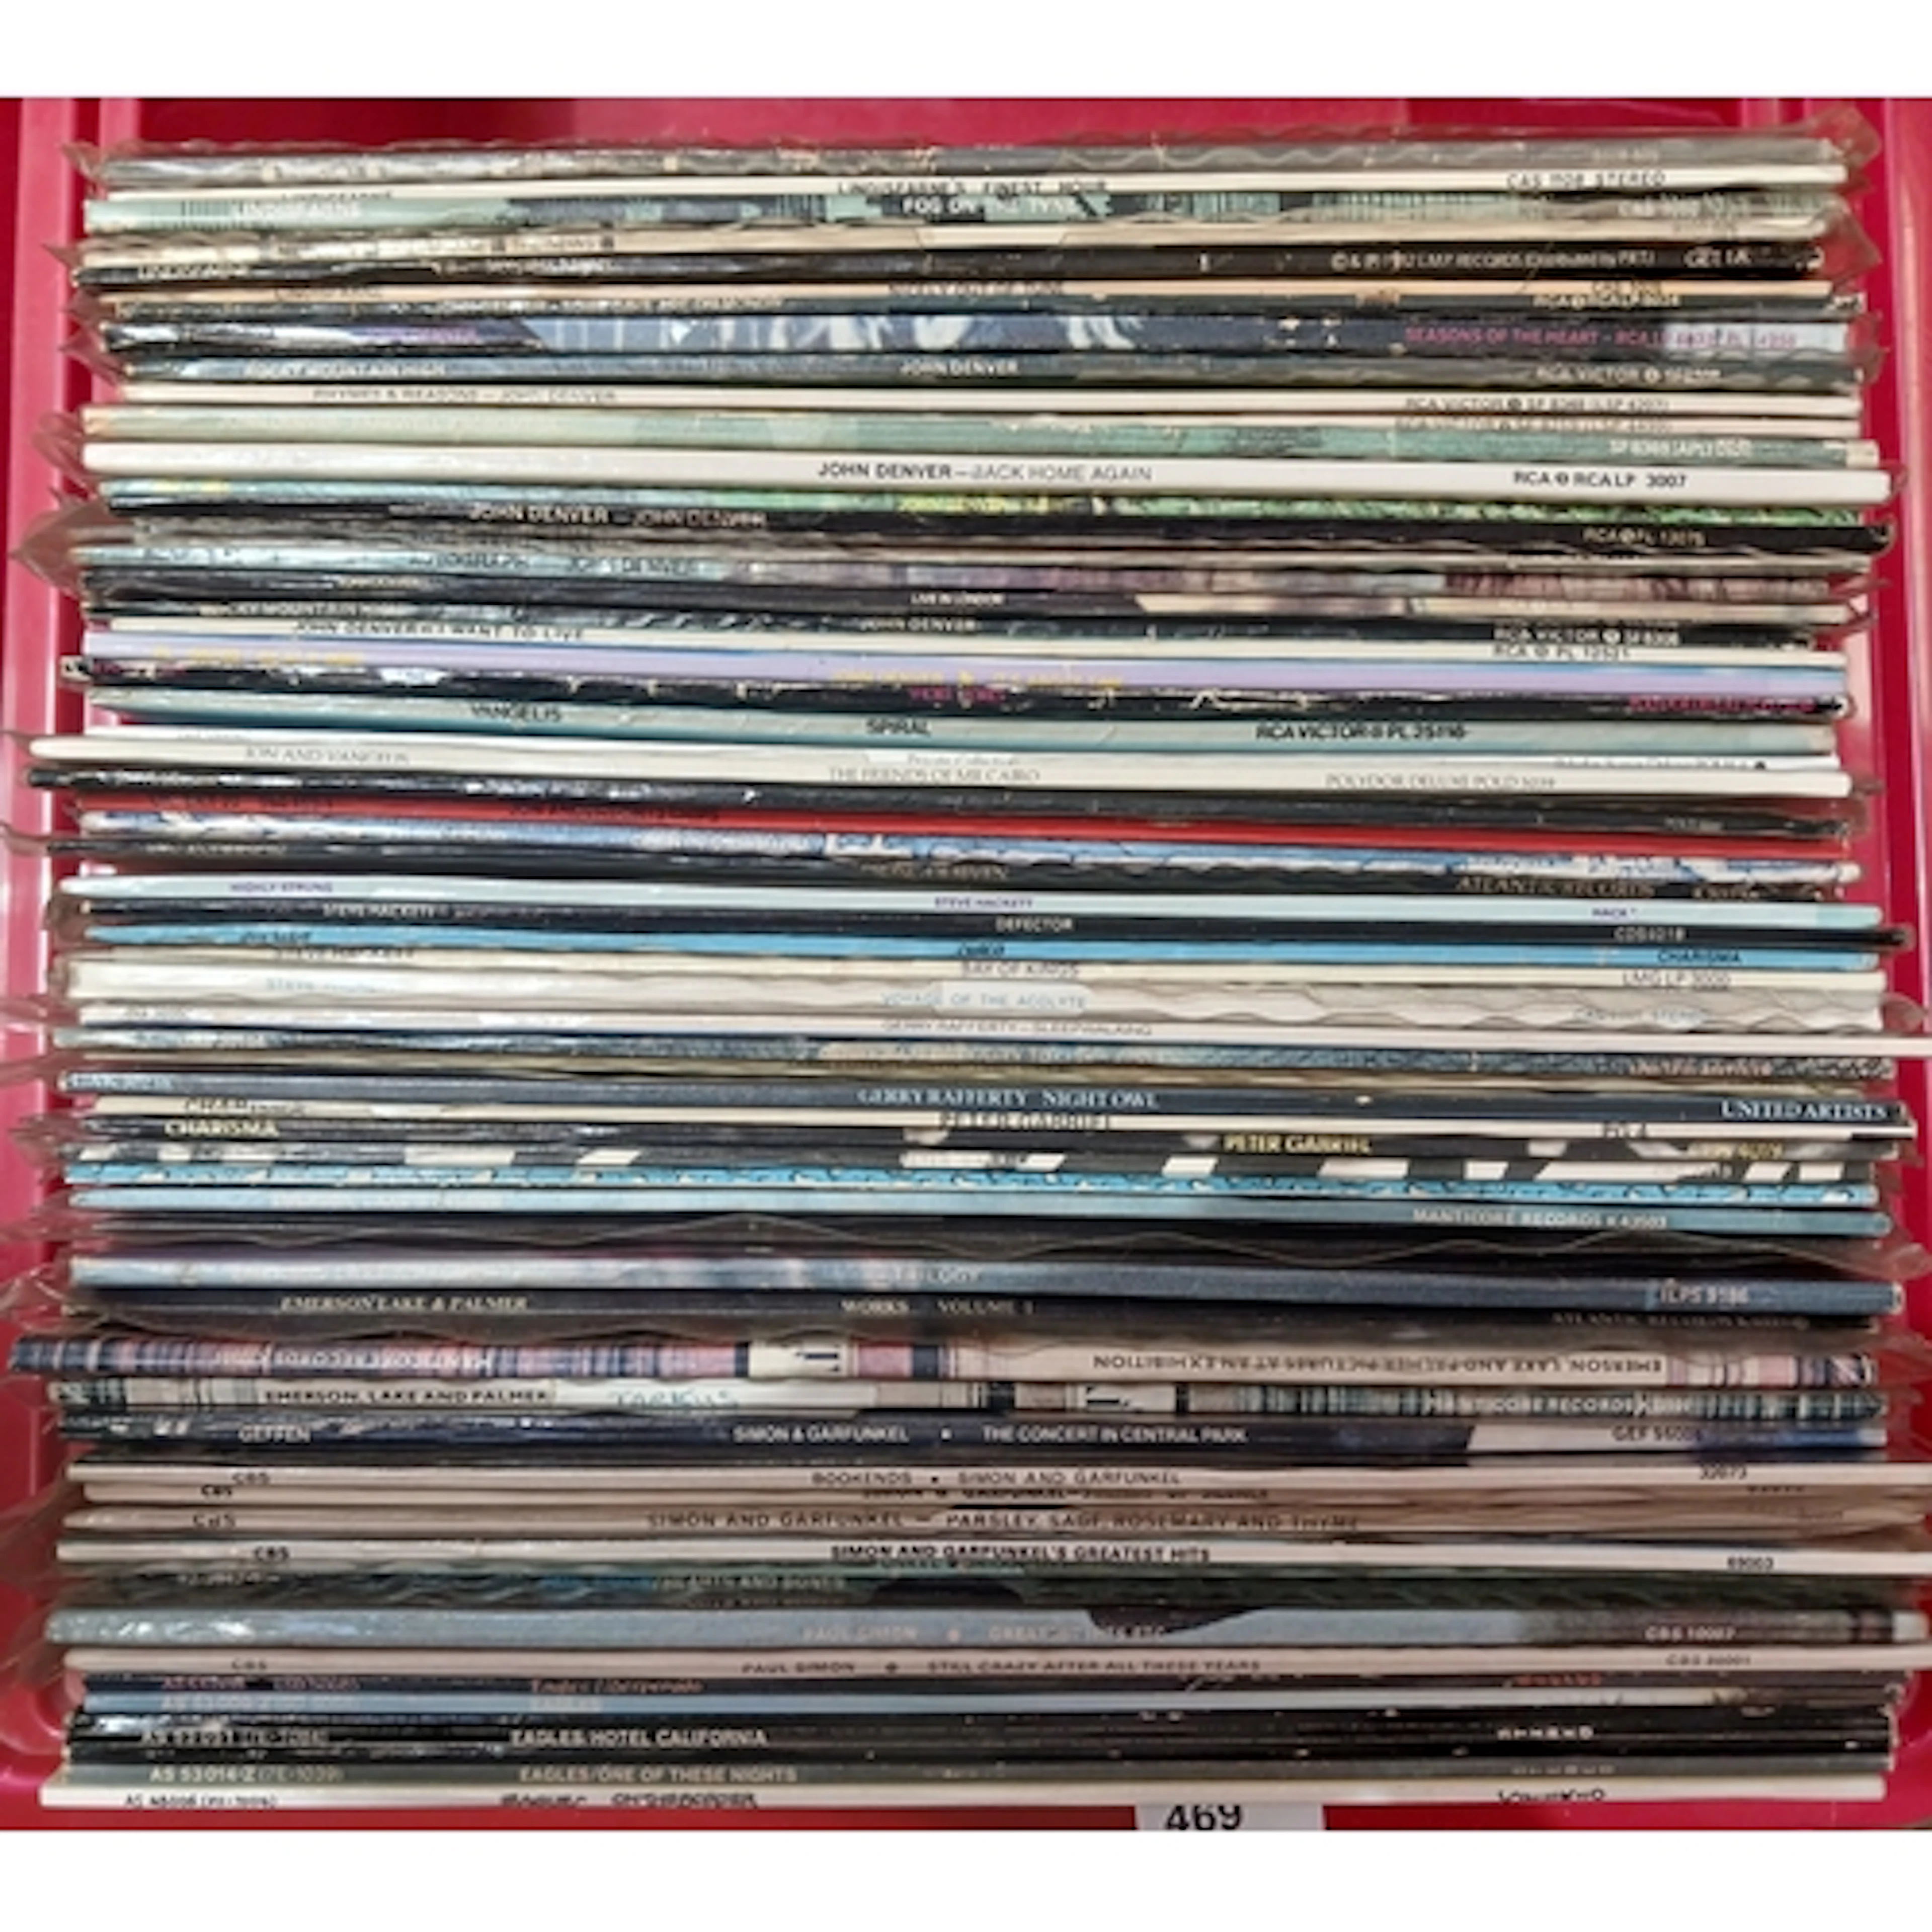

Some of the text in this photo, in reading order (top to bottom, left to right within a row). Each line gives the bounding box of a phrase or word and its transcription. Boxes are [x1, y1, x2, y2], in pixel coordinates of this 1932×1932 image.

[904, 197, 940, 214] FOG
[949, 197, 975, 214] ON
[1405, 329, 1482, 347] SEASONS
[1545, 329, 1600, 347] HEART
[818, 462, 1152, 481] JOHN DENVER BACK HOME AGAIN
[1513, 470, 1686, 487] RCA 3007
[469, 505, 522, 522] JOHN
[527, 505, 608, 522] DENVER
[471, 703, 561, 722] VANGELIS
[995, 916, 1075, 932] DEFECTOR
[858, 1088, 923, 1108] GERRY
[927, 1088, 1026, 1108] RAFFERTY
[1721, 1100, 1888, 1121] UNITED ARTISTS
[164, 1120, 280, 1138] CHARISMA
[1224, 1134, 1282, 1155] PETER
[449, 1295, 527, 1311] PALMER
[367, 1389, 548, 1404] LAKE AND PALMER
[734, 1426, 790, 1442] SIMON
[807, 1426, 909, 1442] GARFUNKEL
[983, 1426, 1013, 1442] THE
[1018, 1426, 1098, 1442] CONCERT
[1101, 1426, 1117, 1442] IN
[1120, 1426, 1197, 1442] CENTRAL
[1200, 1426, 1247, 1442] PARK
[958, 1471, 1018, 1485] SIMON
[1025, 1471, 1065, 1485] AND
[1074, 1471, 1180, 1485] GARFUNKEL
[648, 1513, 716, 1528] SIMON
[725, 1513, 771, 1528] AND
[831, 1545, 892, 1561] SIMON
[899, 1545, 939, 1561] AND
[1074, 1545, 1165, 1561] GREATEST
[742, 1661, 788, 1673] PAUL
[794, 1661, 855, 1673] SIMON
[929, 1661, 974, 1673] STILL
[1044, 1661, 1099, 1673] AFTER
[1106, 1661, 1135, 1673] ALL
[1207, 1661, 1261, 1673] YEARS
[589, 1730, 651, 1748] HOTEL
[656, 1730, 769, 1748] CALIFORNIA
[639, 1765, 798, 1782] OF THESE NIGHTS
[1164, 1803, 1243, 1830] 469
